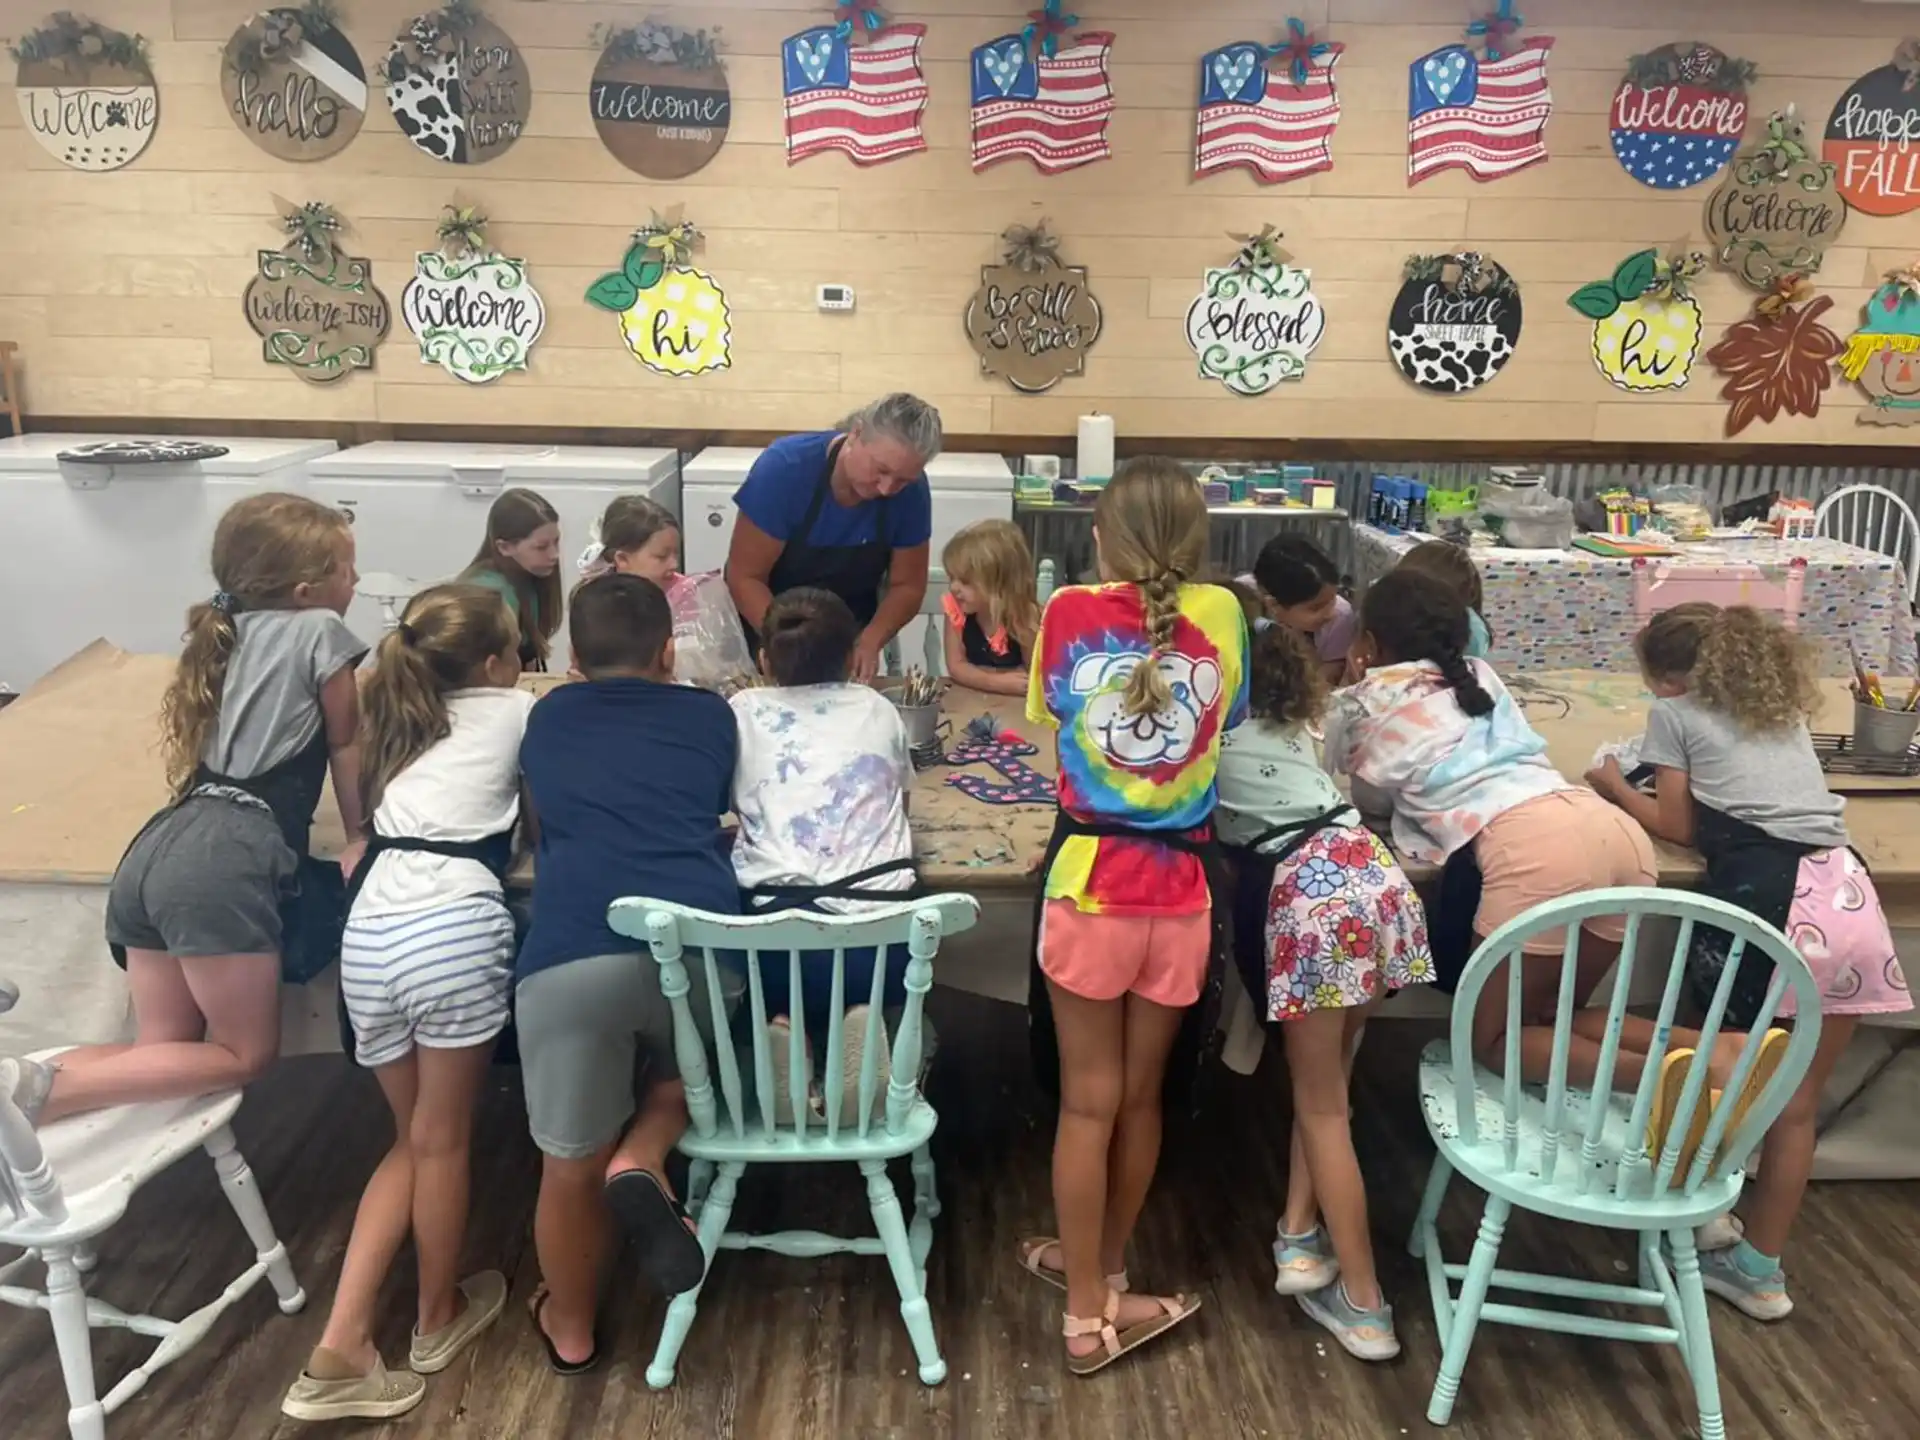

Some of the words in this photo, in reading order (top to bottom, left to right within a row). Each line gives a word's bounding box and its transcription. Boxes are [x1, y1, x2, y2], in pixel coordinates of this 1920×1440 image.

[233, 69, 352, 142] hello
[594, 84, 728, 121] Welcome
[1615, 83, 1745, 134] Welcome
[1844, 149, 1920, 196] FALL
[1719, 189, 1833, 237] Welcome
[411, 284, 532, 337] Welcome
[1197, 298, 1314, 352] blessed
[1409, 283, 1507, 324] home
[652, 309, 704, 358] hi
[1620, 318, 1677, 376] hi
